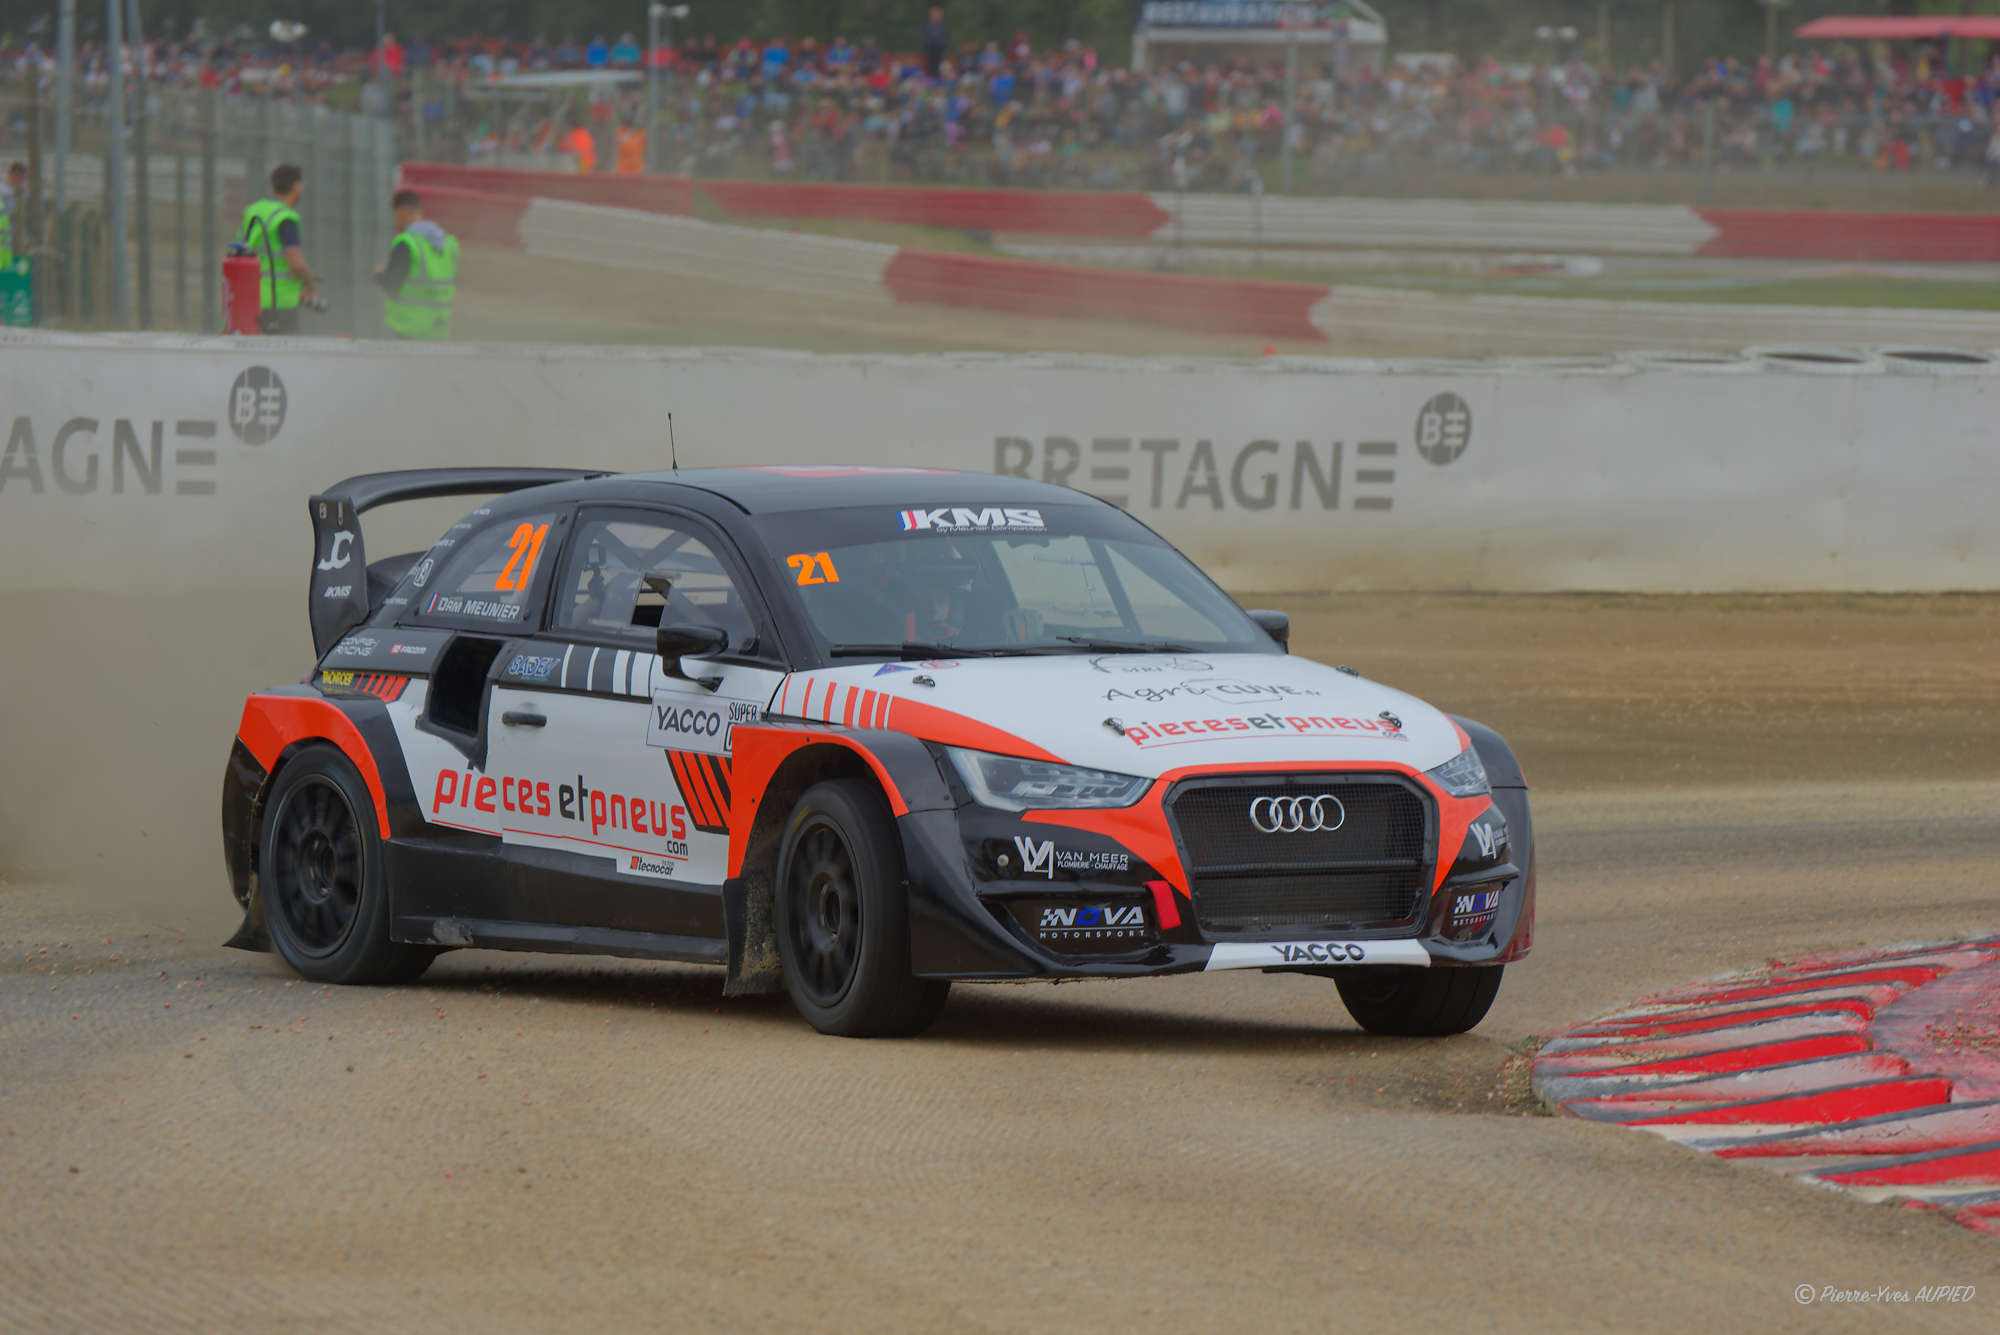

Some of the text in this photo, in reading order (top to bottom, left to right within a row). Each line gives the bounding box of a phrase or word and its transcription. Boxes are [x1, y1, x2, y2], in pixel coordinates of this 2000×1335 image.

[995, 437, 1398, 512] BRETAGNE
[494, 522, 549, 591] 21
[786, 552, 839, 586] 21
[463, 600, 520, 620] MEUNIER
[656, 705, 721, 737] YACCO
[729, 702, 758, 722] SUPER
[1055, 850, 1129, 864] VAN MEER
[1049, 906, 1145, 927] NOVA
[1039, 930, 1145, 940] MOTORSPORT
[1272, 943, 1366, 962] YACCO
